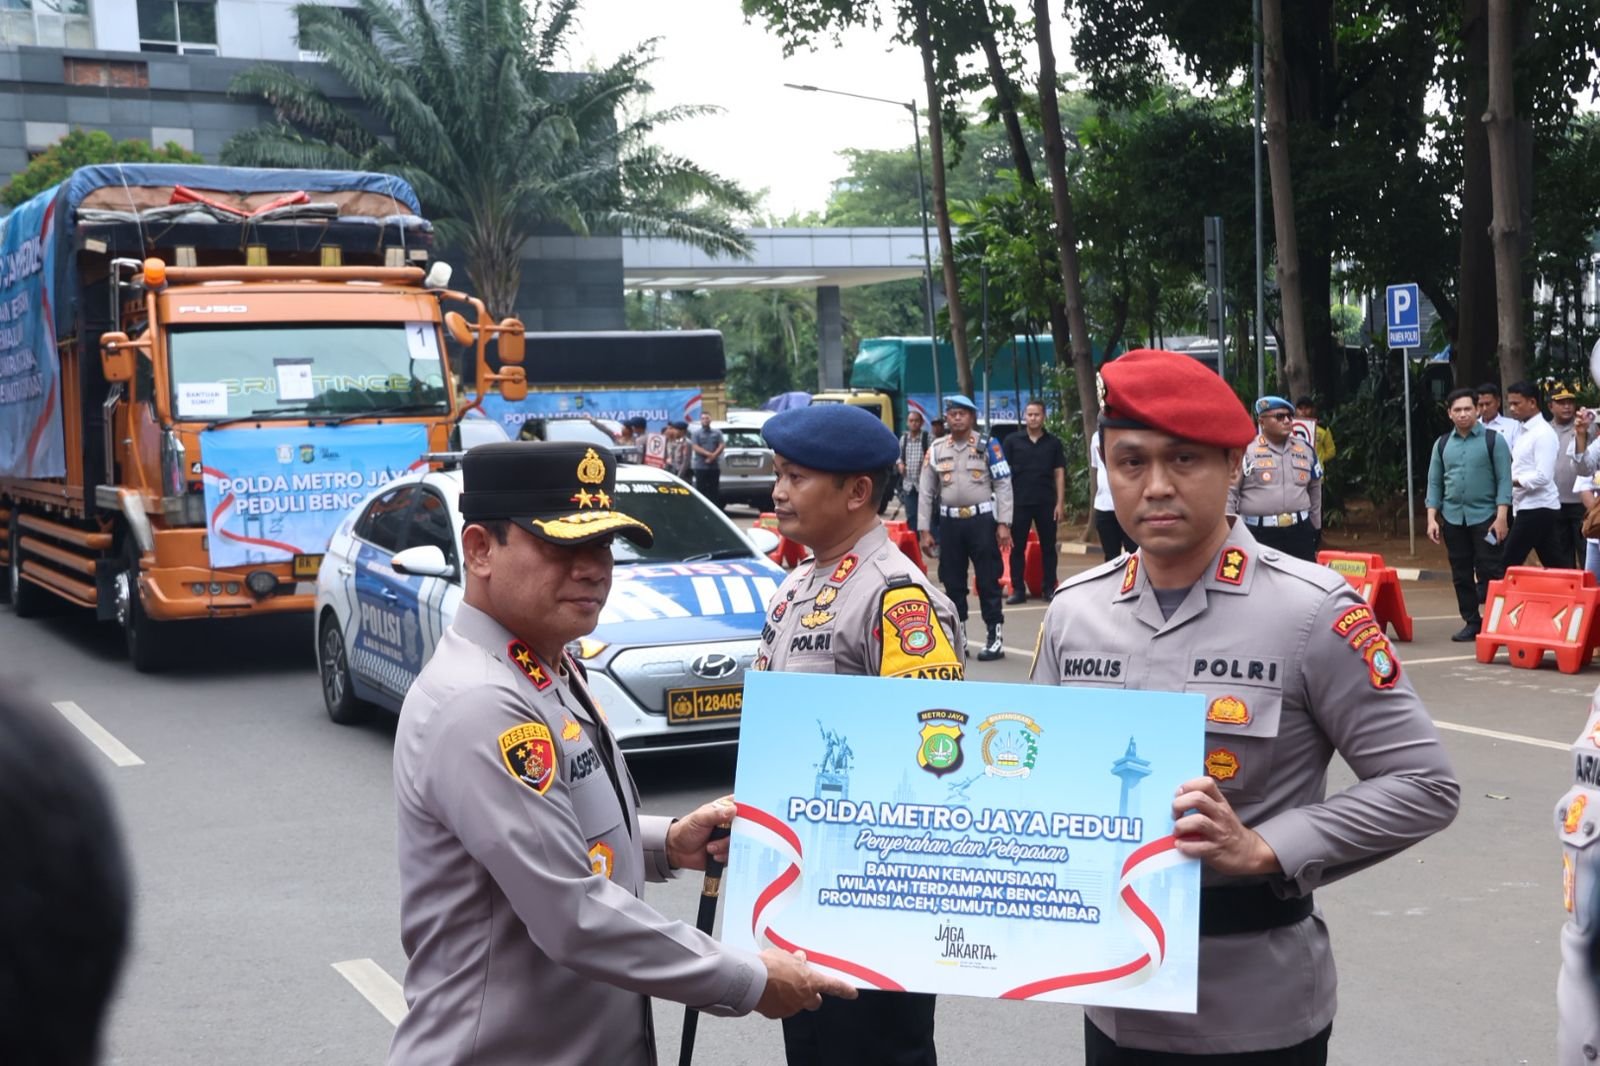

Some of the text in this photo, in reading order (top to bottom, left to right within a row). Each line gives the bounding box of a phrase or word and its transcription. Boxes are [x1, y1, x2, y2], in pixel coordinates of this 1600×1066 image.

[178, 305, 248, 314] FUSO
[1393, 289, 1411, 325] P
[416, 327, 427, 347] 1
[218, 474, 288, 495] POLDA
[292, 471, 362, 492] METRO
[236, 496, 305, 515] PEDULI
[891, 604, 925, 619] POLDA
[1338, 608, 1370, 631] POLDA
[361, 602, 401, 647] POLISI
[790, 633, 831, 652] POLRI
[1063, 658, 1122, 678] KHOLIS
[1193, 658, 1277, 682] POLRI
[698, 692, 742, 712] 128405
[921, 711, 965, 722] METRO JAYA
[788, 797, 1143, 842] POLDA METRO JAYA PEDULI
[855, 829, 1069, 865] Penyerahan dan Pelepasan
[866, 862, 1055, 888] BANTUAN KEMANUSIAAN
[838, 876, 1082, 905] WILAYAH TERDAMPAK BENCANA
[819, 889, 1100, 923] PROVINSI ACEH, SUMUT DAN SUMBAR
[934, 923, 965, 943] JAGA
